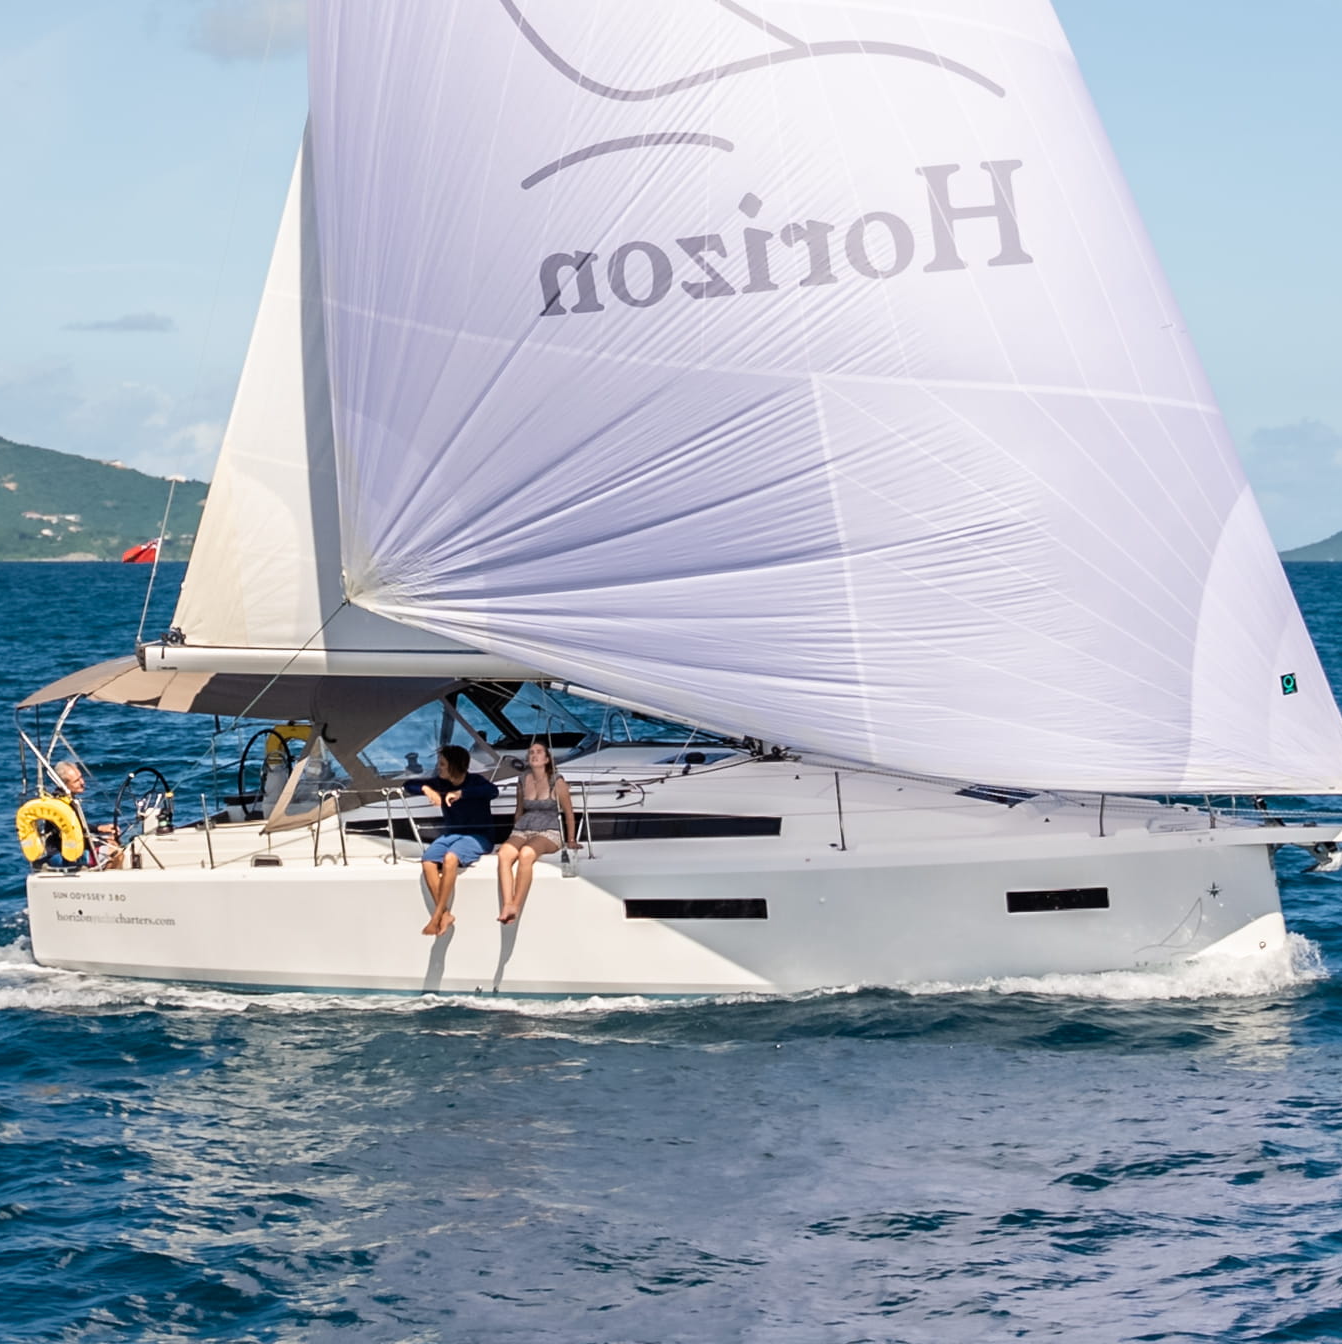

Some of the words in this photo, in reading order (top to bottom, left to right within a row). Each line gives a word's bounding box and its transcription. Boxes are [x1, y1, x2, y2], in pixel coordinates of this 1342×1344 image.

[52, 891, 68, 899] SUN
[69, 892, 105, 901] ODYSSEY
[56, 910, 176, 926] horizoncharters.com
